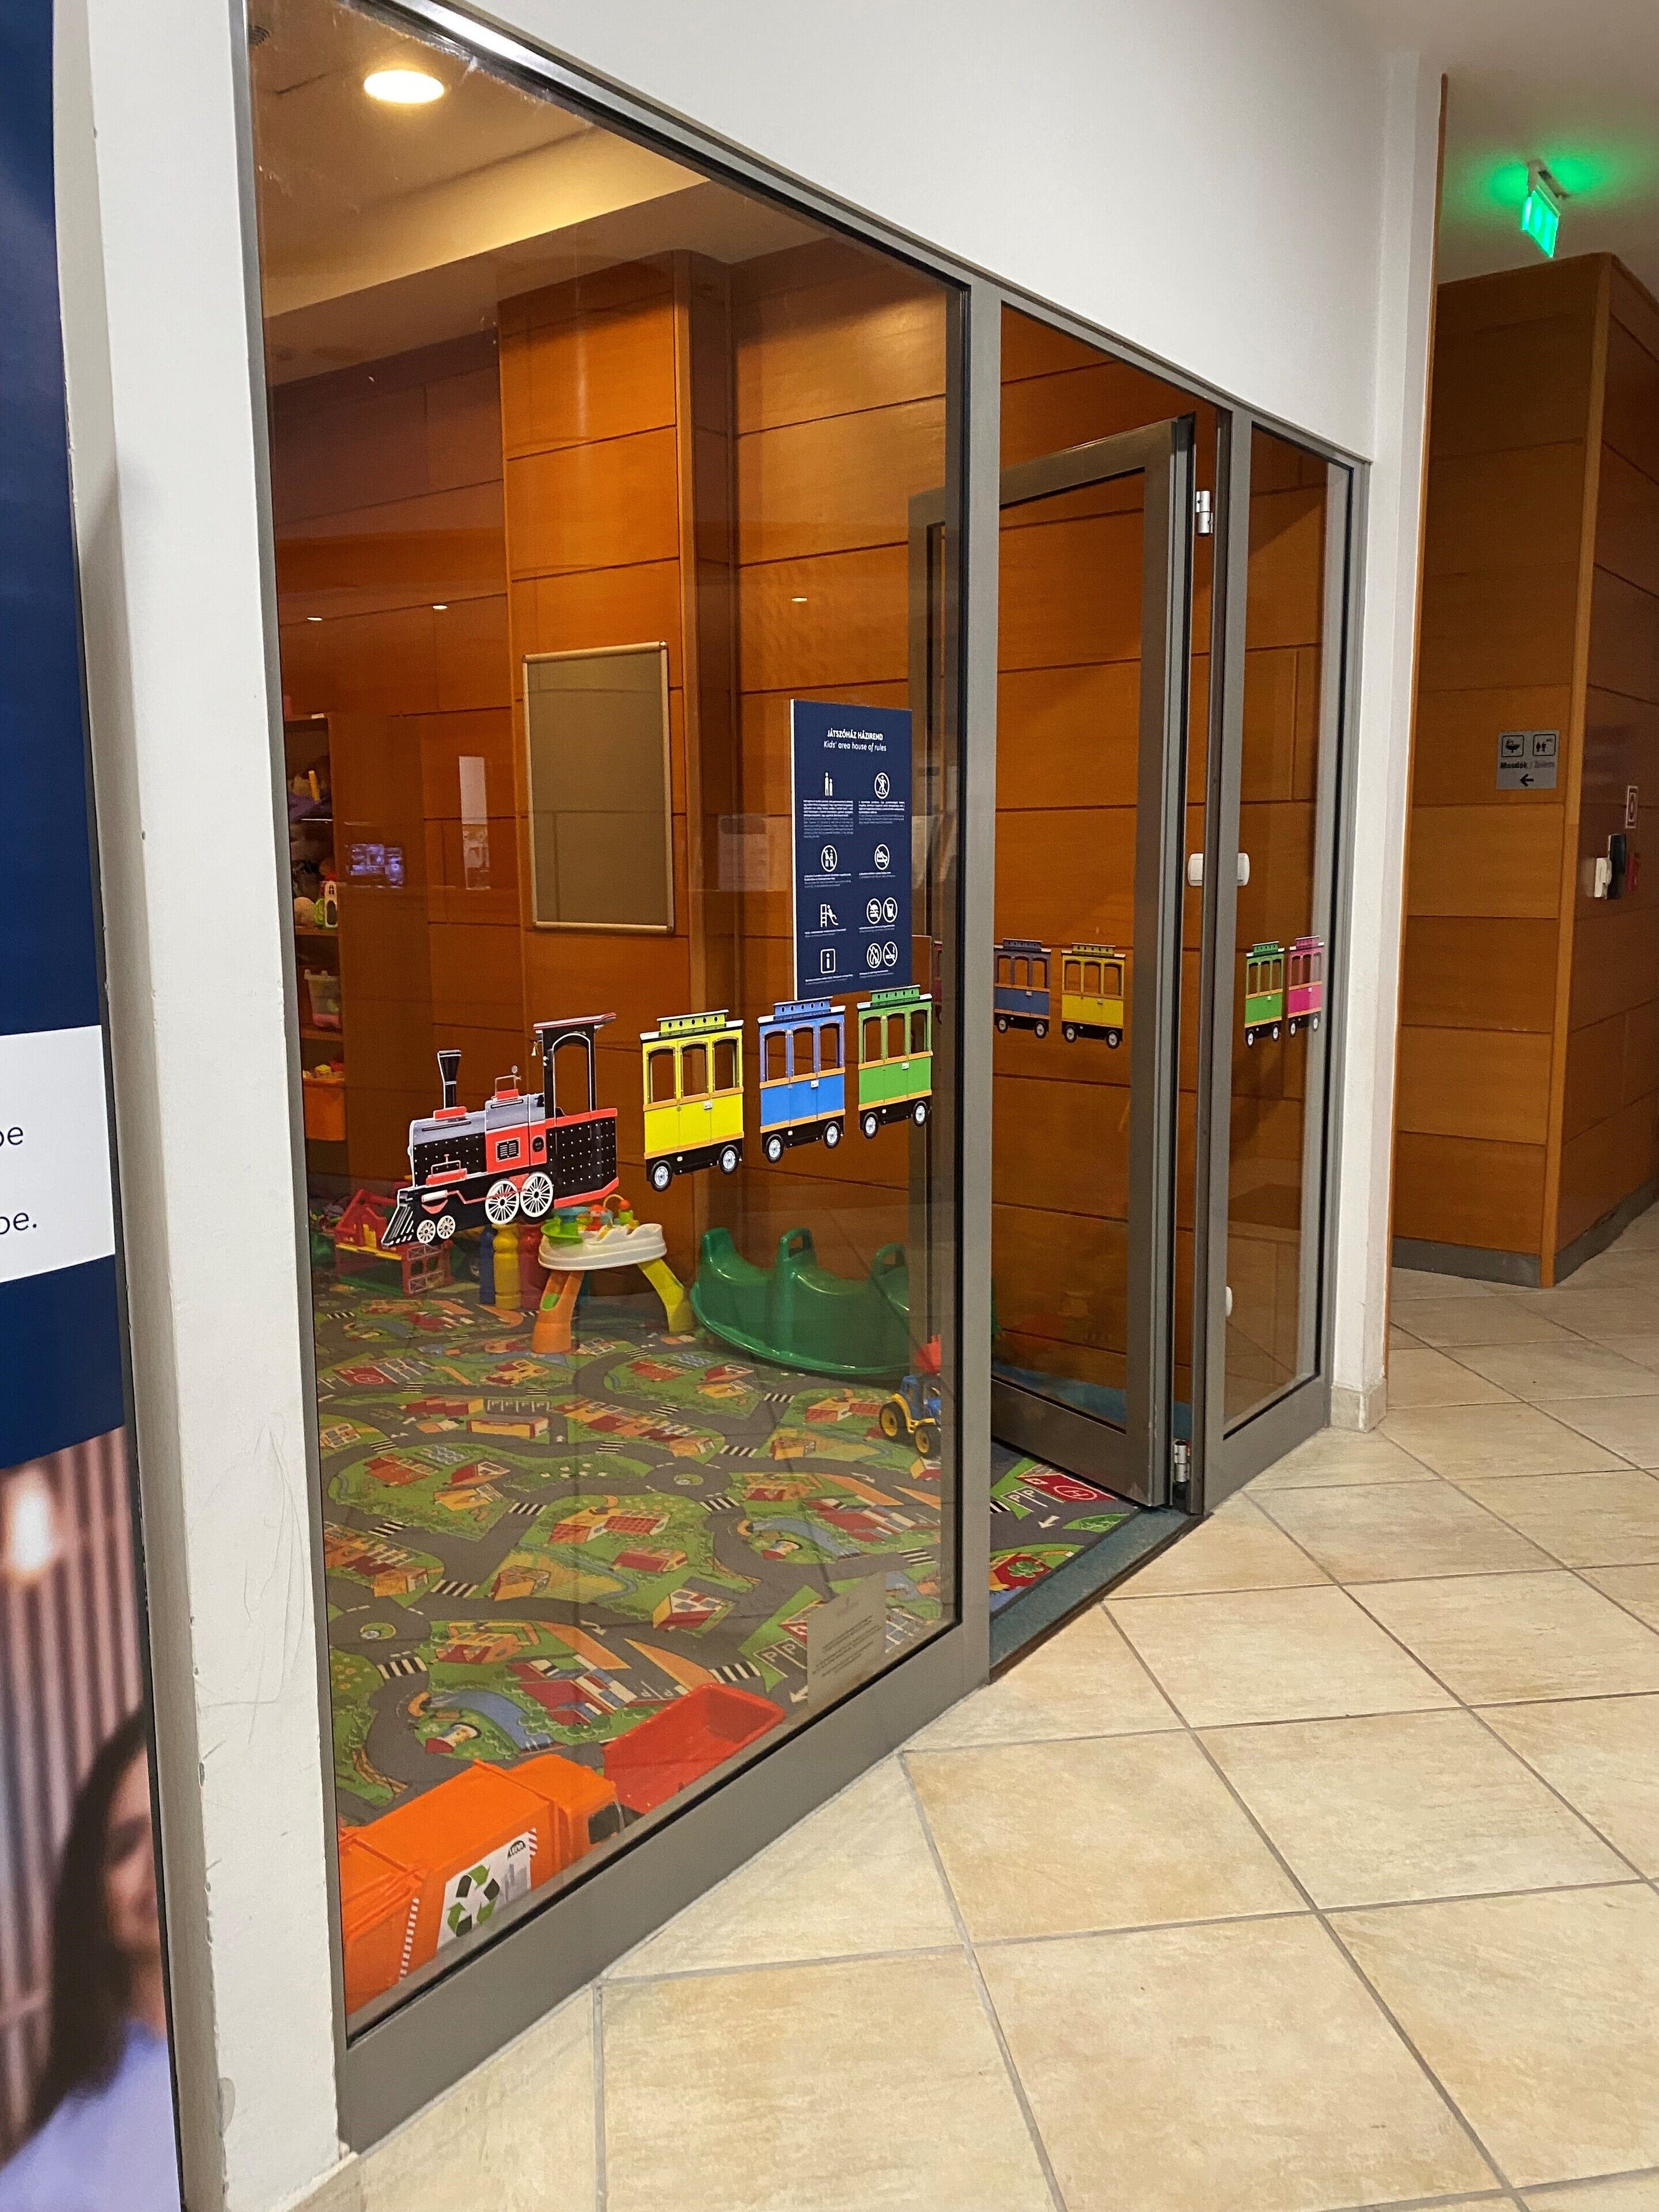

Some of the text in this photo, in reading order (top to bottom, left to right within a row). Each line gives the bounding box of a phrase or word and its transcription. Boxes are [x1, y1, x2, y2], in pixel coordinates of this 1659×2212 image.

[858, 730, 883, 741] HÁZIREND
[851, 742, 867, 751] house
[868, 743, 874, 752] of
[874, 743, 887, 751] rules
